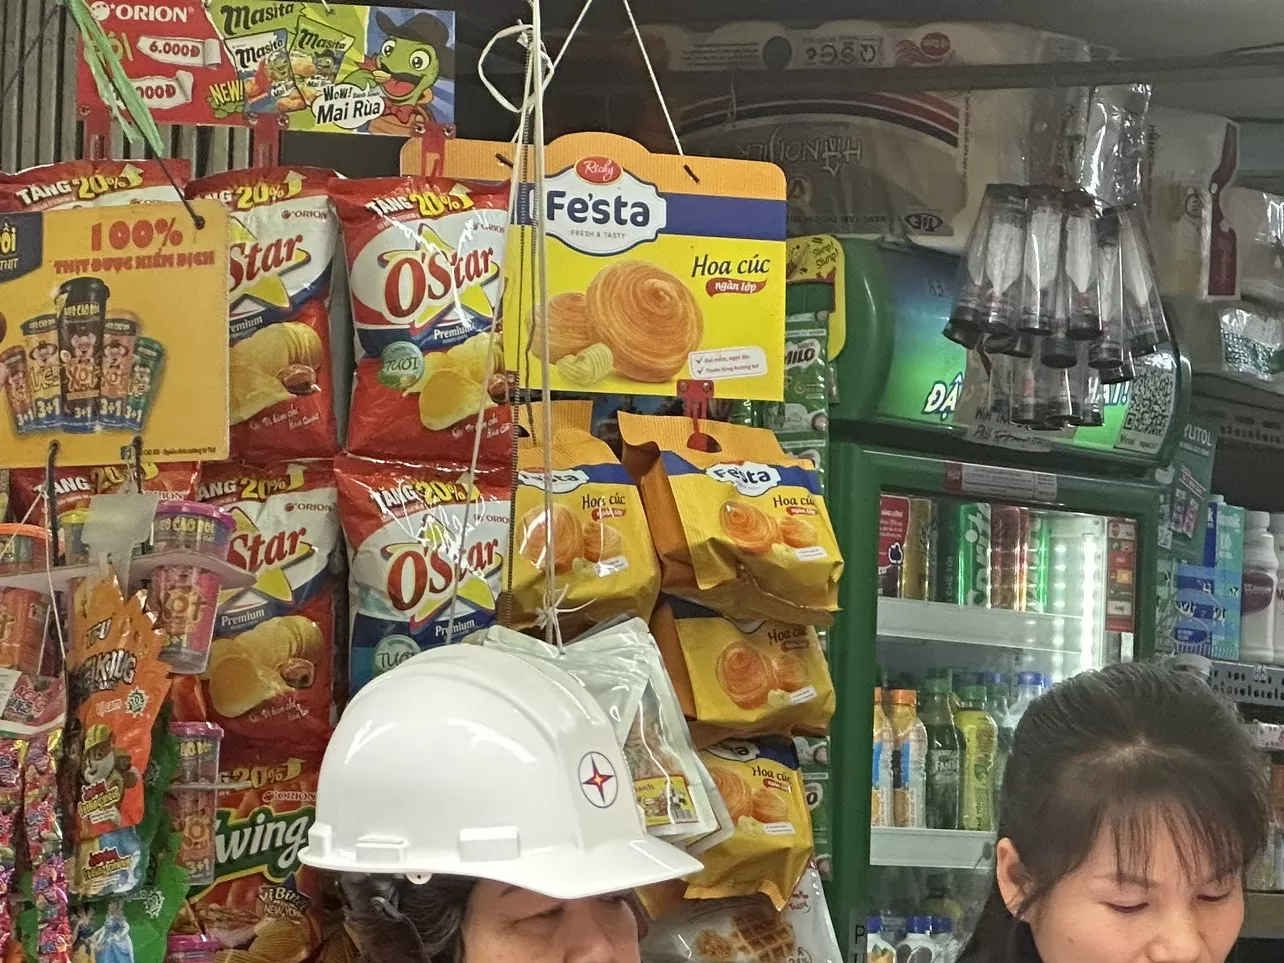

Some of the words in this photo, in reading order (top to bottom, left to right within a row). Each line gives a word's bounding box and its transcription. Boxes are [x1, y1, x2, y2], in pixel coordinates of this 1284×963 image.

[115, 4, 188, 23] ORION
[220, 2, 294, 35] Masita
[298, 28, 347, 50] Masita
[236, 38, 284, 69] Masita
[209, 80, 245, 106] NEW!
[316, 103, 349, 125] Mai
[352, 100, 381, 119] Rùa
[583, 160, 615, 179] Richy
[15, 179, 73, 205] TĂNG
[76, 173, 127, 199] 20%
[205, 189, 233, 202] NG
[236, 183, 285, 208] 20%
[292, 209, 329, 219] ORION
[365, 196, 414, 217] TĂNG
[409, 192, 460, 216] 20%
[546, 189, 651, 228] Fe'sta
[91, 217, 183, 253] 100%
[570, 229, 597, 239] FRESH
[603, 230, 627, 241] TASTY
[54, 259, 90, 275] THỊT
[177, 251, 215, 269] DỊCH
[228, 232, 304, 294] Star
[692, 255, 731, 277] Hoa
[737, 253, 771, 274] cúc
[385, 246, 495, 322] O'Star
[740, 281, 757, 294] lớp
[230, 314, 263, 335] emium
[433, 323, 476, 341] Premium
[37, 397, 62, 418] 3+1
[74, 405, 92, 418] 3+1
[100, 398, 122, 416] 3+1
[124, 405, 143, 422] 3+1
[240, 477, 286, 502] 20%
[415, 479, 466, 505] 20%
[608, 493, 626, 506] cúc
[773, 494, 798, 508] Hoa
[229, 525, 308, 572] Star
[221, 607, 265, 628] Premium
[768, 629, 790, 646] Hoa
[233, 767, 284, 788] 20%
[752, 765, 775, 779] Hoa
[215, 812, 309, 869] wing
